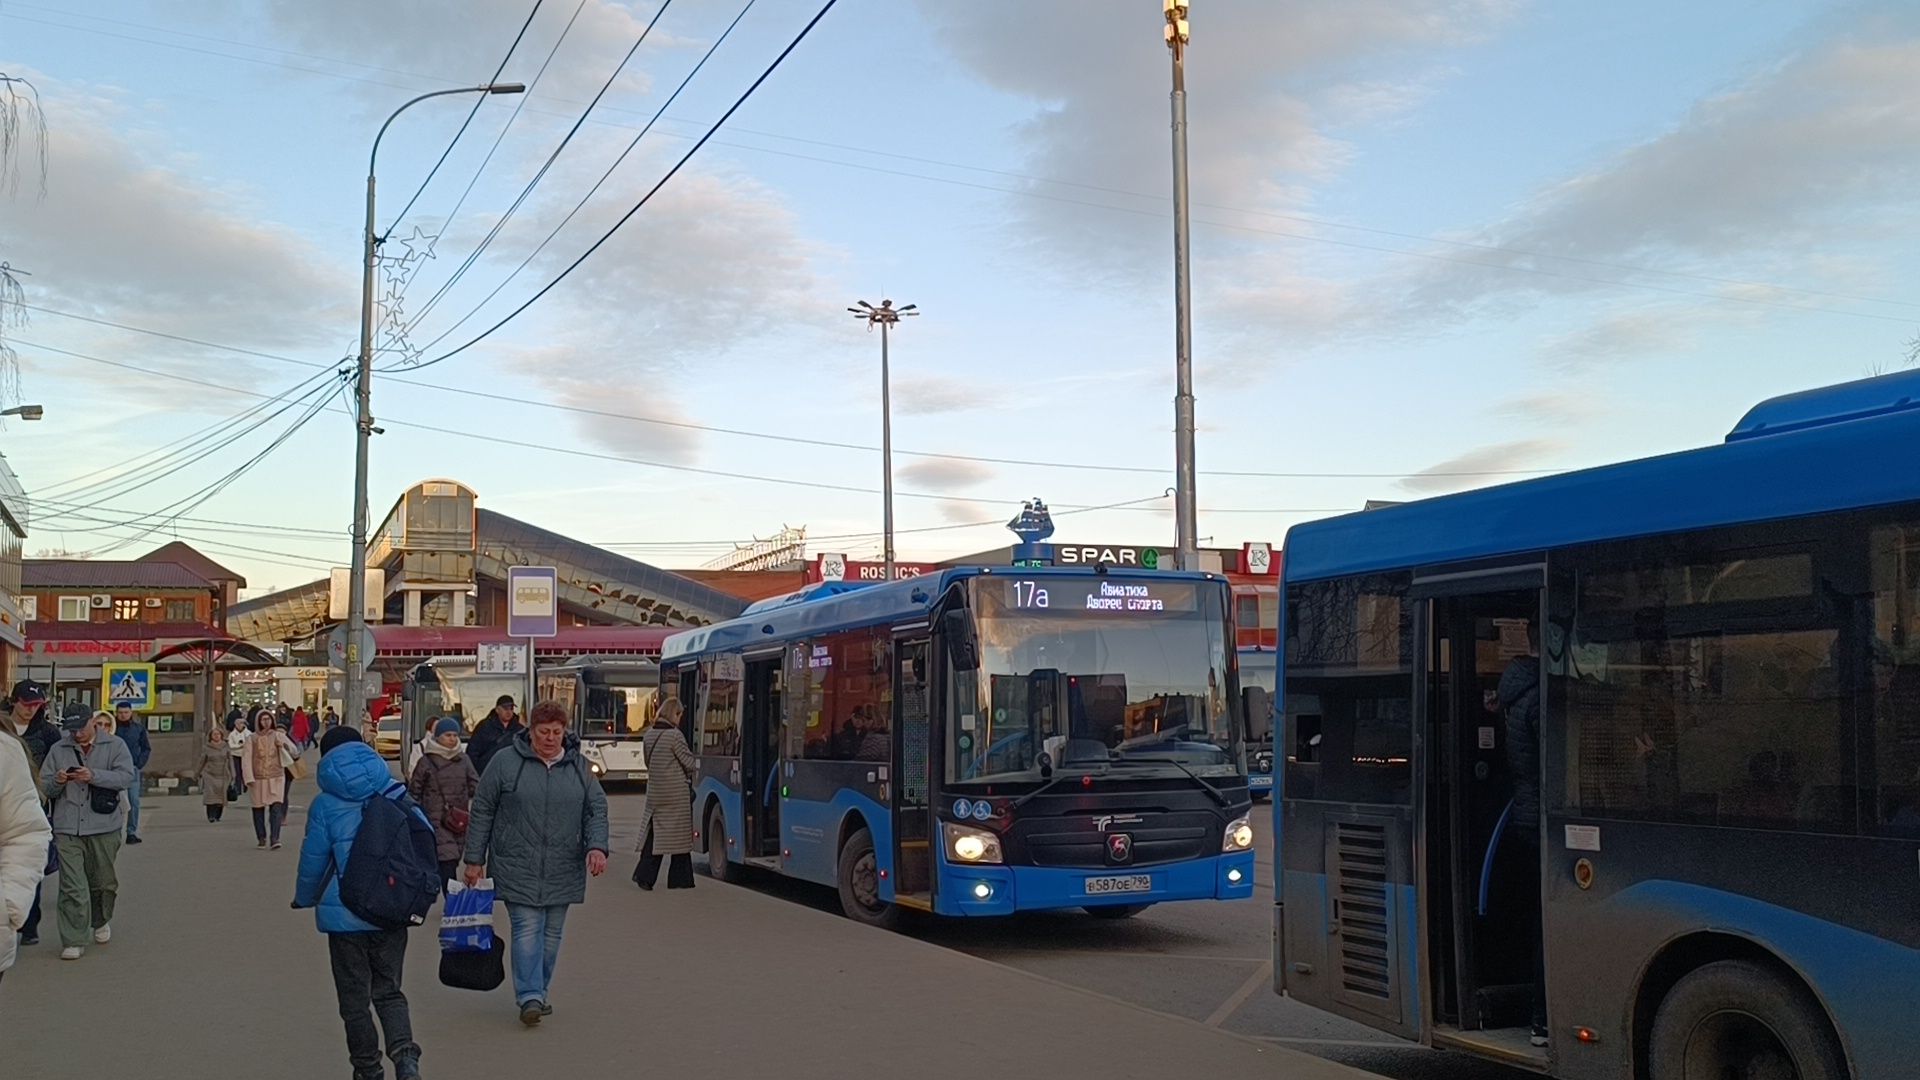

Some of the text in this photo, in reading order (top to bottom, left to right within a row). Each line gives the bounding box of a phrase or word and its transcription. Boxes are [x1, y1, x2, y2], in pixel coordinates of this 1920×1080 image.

[1061, 547, 1136, 564] SPAR
[860, 566, 921, 579] ROSIC'S
[1013, 581, 1049, 608] 17а
[1101, 581, 1148, 597] Авиатика
[1086, 594, 1123, 610] Дворец
